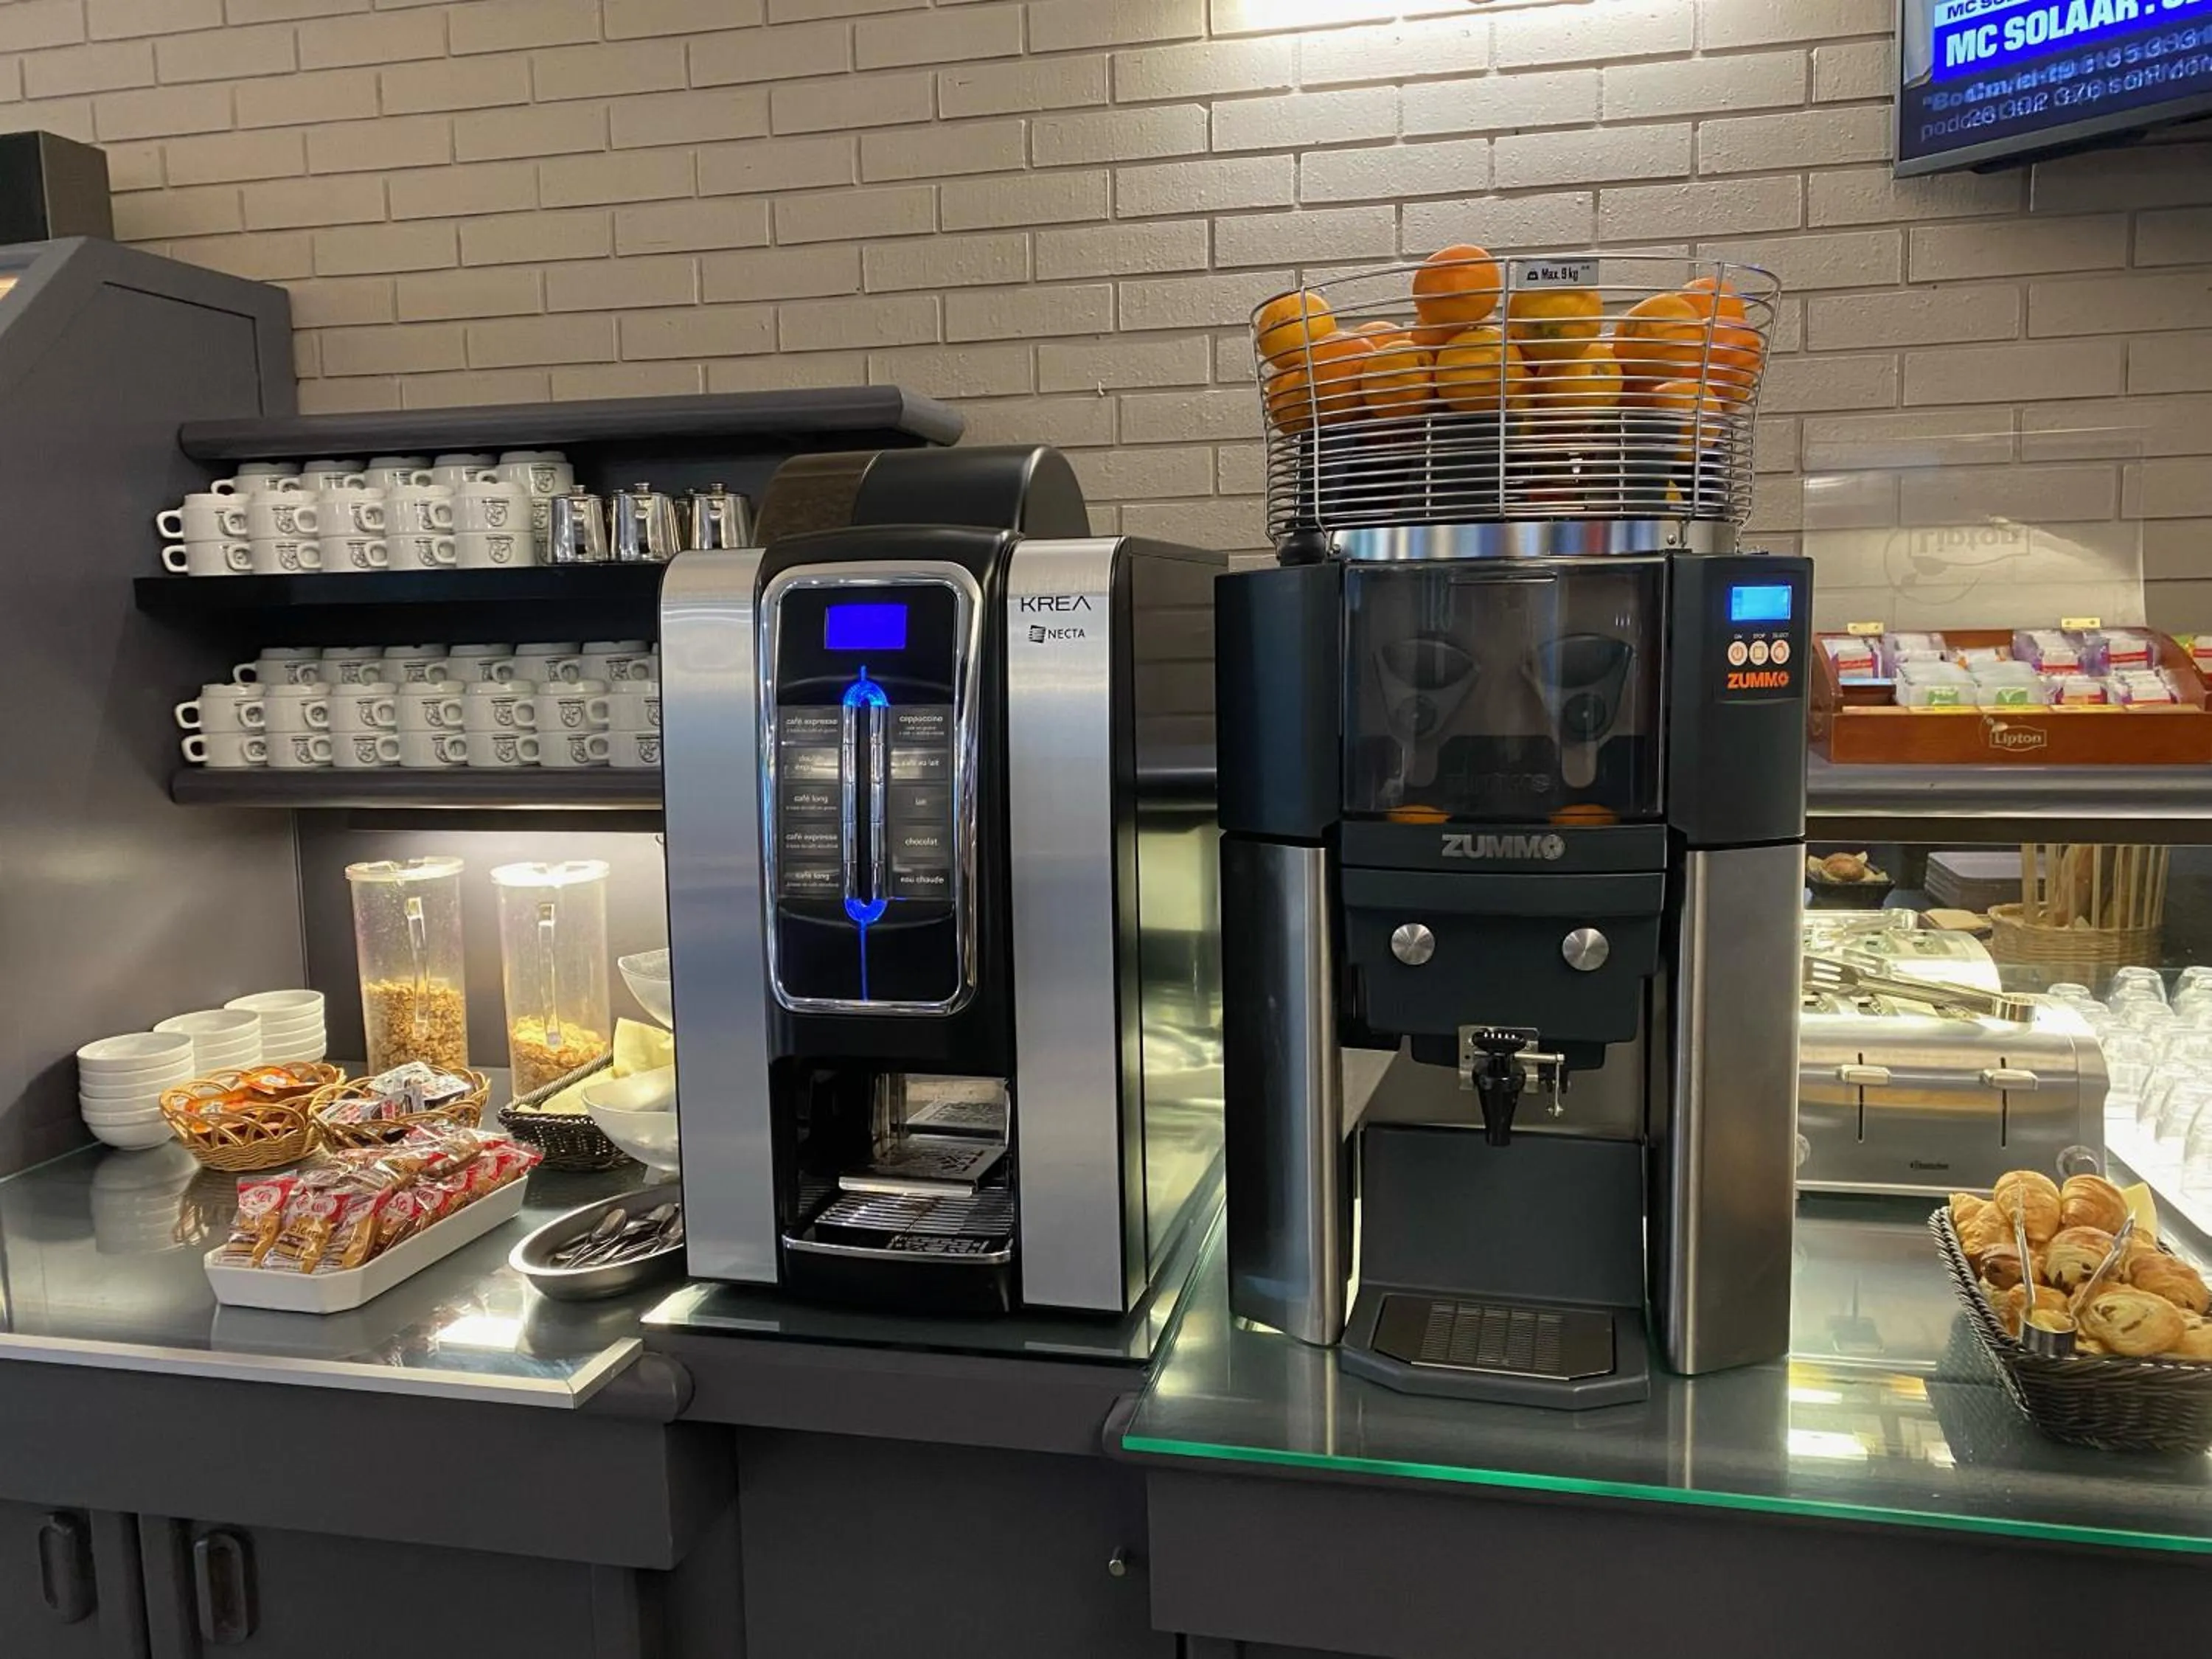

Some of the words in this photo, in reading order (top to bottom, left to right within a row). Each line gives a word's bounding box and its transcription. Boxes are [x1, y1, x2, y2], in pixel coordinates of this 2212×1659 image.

[1946, 24, 1998, 68] MC
[1020, 595, 1092, 612] KREA
[1048, 628, 1085, 639] NECTA
[1727, 671, 1790, 689] ZUMMO
[1994, 731, 2042, 747] Lipton
[905, 838, 939, 846] chocolat
[1441, 833, 1566, 860] ZUMMO
